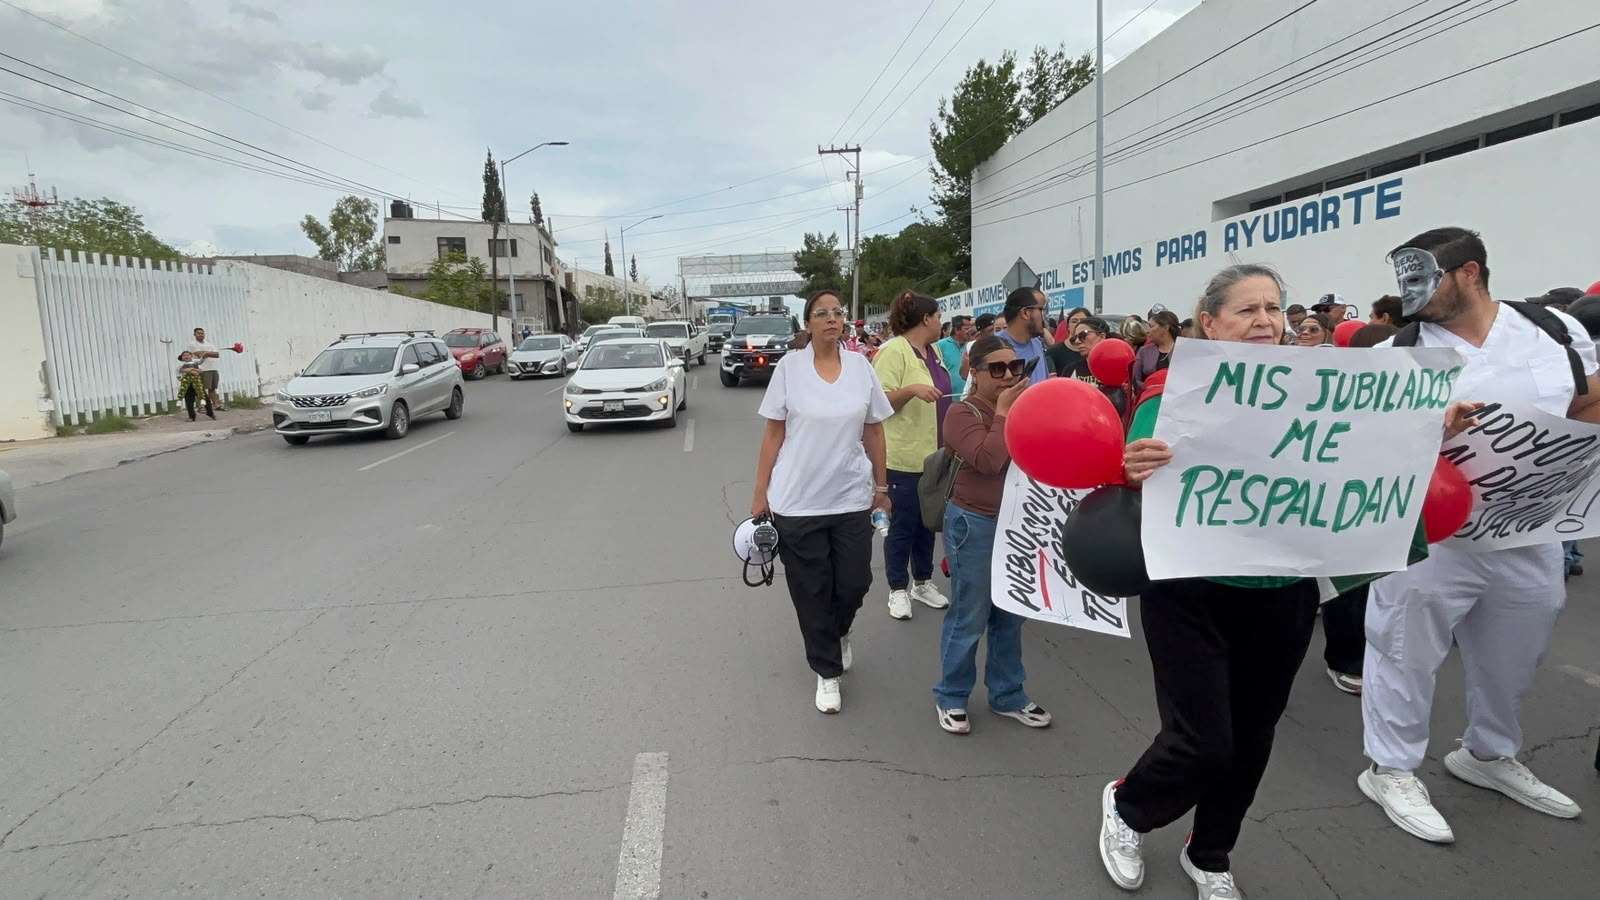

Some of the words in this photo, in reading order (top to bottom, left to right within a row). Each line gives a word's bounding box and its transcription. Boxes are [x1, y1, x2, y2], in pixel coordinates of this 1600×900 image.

[950, 295, 961, 311] POR
[964, 291, 974, 307] UN
[978, 284, 1009, 304] MOMEN
[1040, 268, 1065, 291] ICIL,
[1156, 229, 1207, 266] PARA
[1224, 177, 1403, 252] AYUDARTE
[1047, 294, 1066, 309] RISIS
[1204, 361, 1292, 411] MIS
[1305, 365, 1462, 413] JUBILADOS
[1269, 417, 1352, 463] ME
[1175, 464, 1417, 533] RESPALDAN
[1005, 529, 1041, 612] PUEBLO
